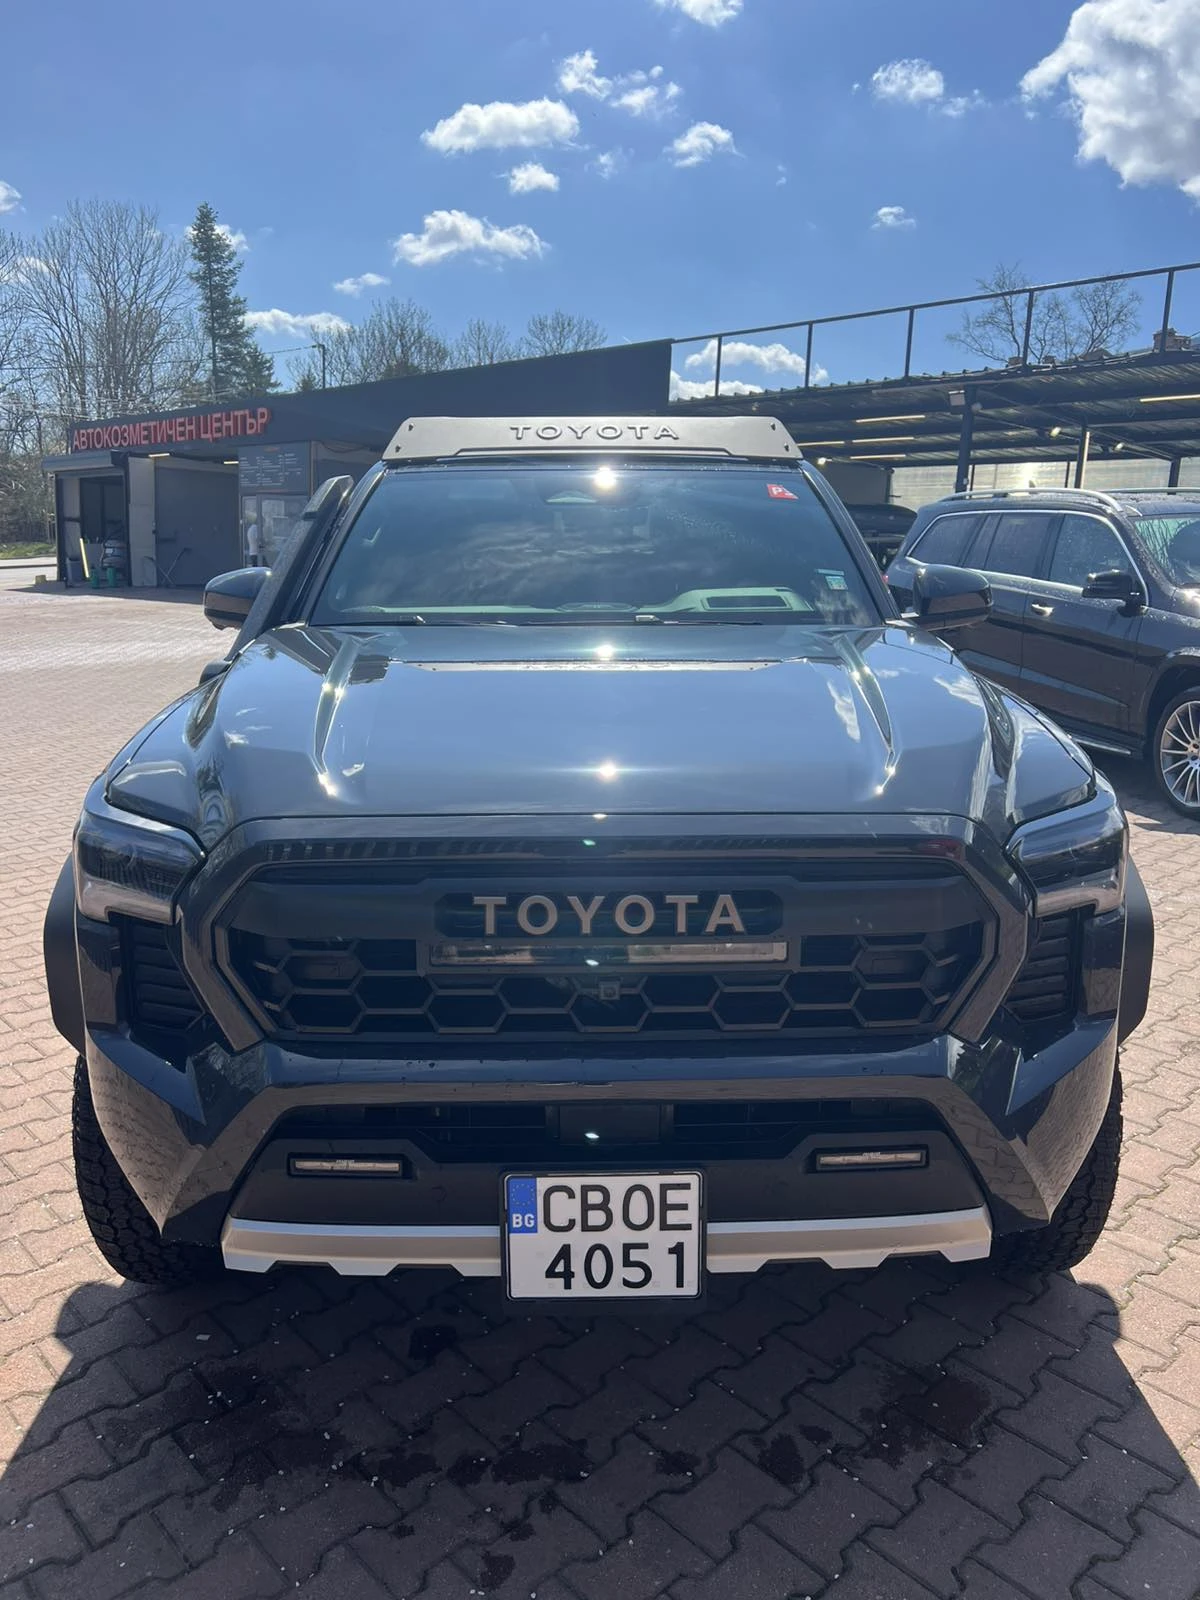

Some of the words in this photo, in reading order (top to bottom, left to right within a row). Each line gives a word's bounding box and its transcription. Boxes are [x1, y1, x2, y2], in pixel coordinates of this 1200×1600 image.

[72, 416, 196, 451] АВТОКОЗМЕТИЧЕН
[200, 407, 269, 442] ЦЕНТЪР
[510, 425, 679, 440] TOYOTA
[473, 895, 745, 936] TOYOTA
[512, 1213, 535, 1229] BG
[545, 1242, 685, 1290] 4051
